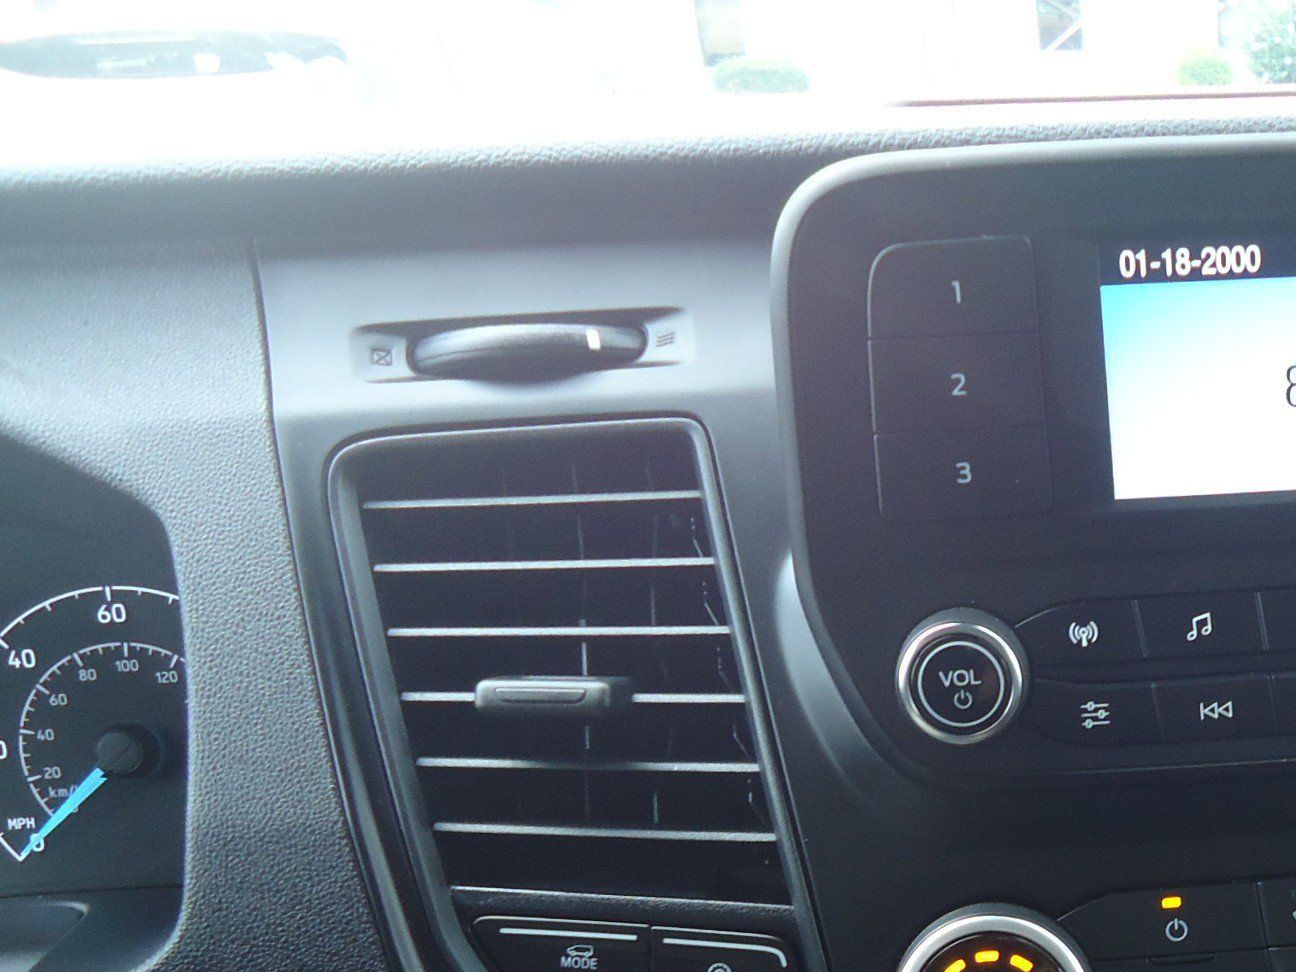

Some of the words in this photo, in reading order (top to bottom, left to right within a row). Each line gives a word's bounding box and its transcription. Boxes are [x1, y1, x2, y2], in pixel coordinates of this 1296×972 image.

[1118, 244, 1262, 279] 01-18-2000
[951, 280, 962, 304] 1
[950, 372, 968, 396] 2
[955, 461, 972, 484] 3
[97, 603, 126, 624] 60
[8, 649, 36, 669] 40
[115, 659, 139, 673] 100
[78, 668, 97, 682] 80
[155, 670, 179, 684] 120
[938, 669, 982, 688] VOL
[49, 693, 68, 706] 60
[36, 728, 55, 741] 40
[43, 766, 62, 779] 20
[7, 817, 36, 830] MPH
[560, 956, 598, 970] MODE
